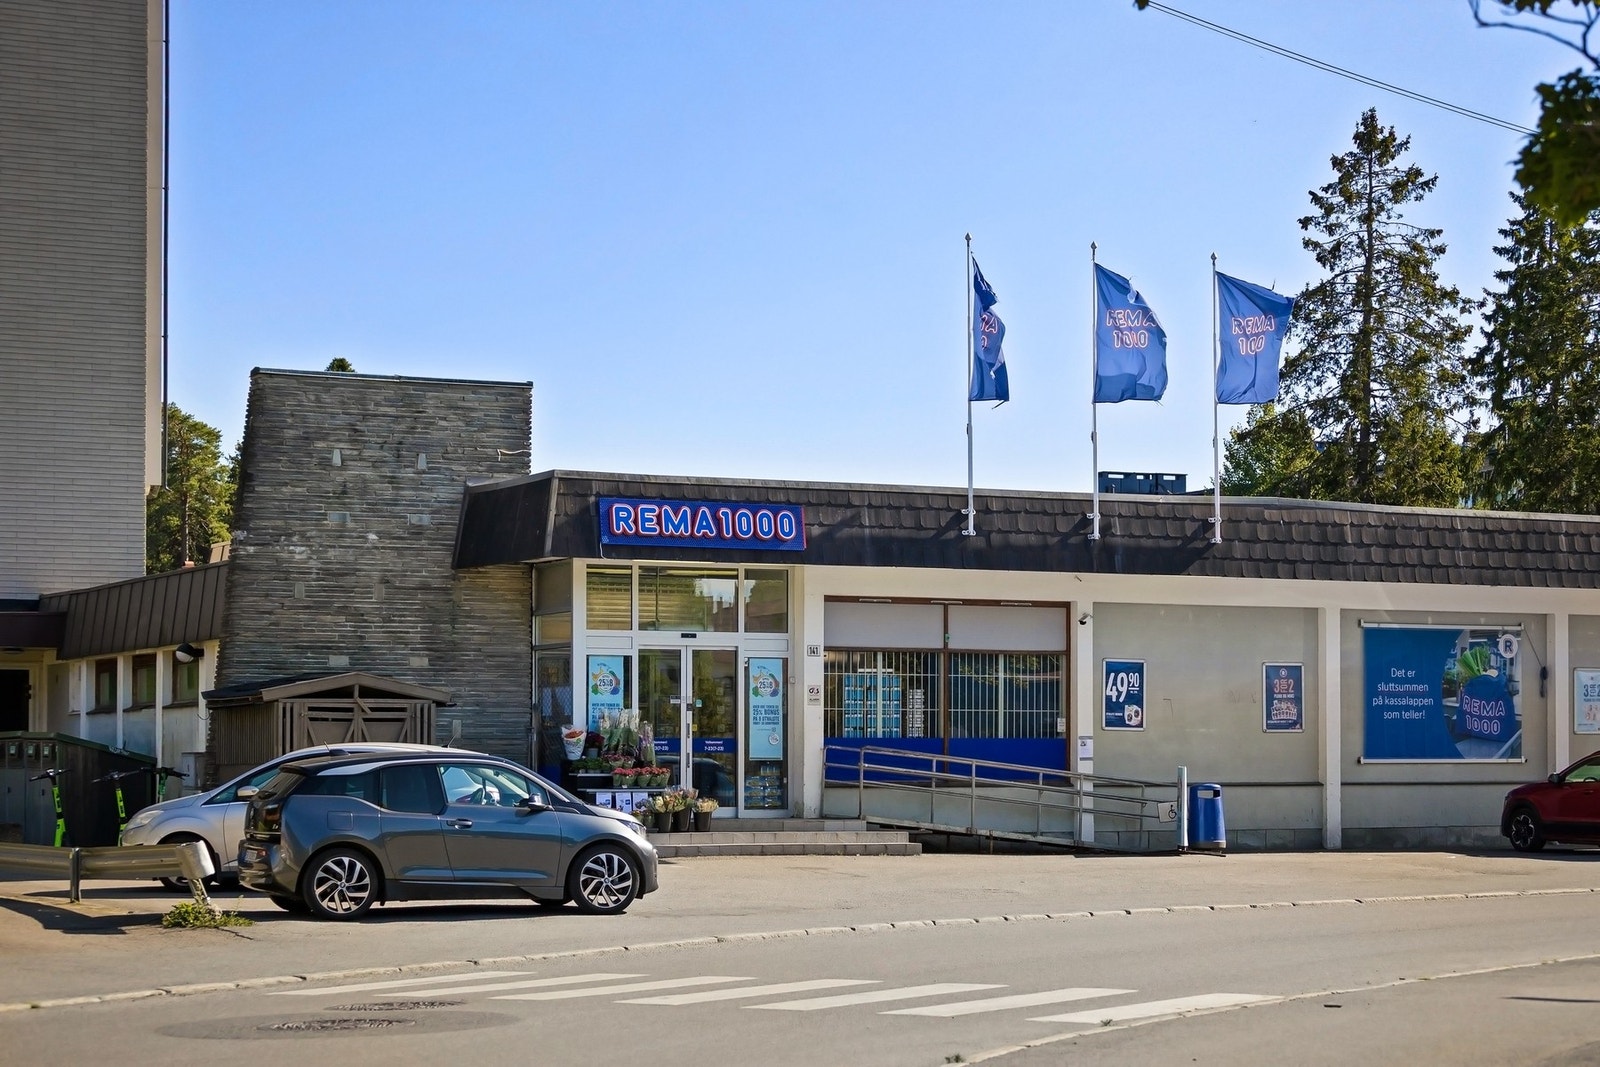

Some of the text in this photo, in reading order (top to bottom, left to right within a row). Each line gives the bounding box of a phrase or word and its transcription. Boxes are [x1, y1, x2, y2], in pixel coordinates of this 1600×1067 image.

[1232, 315, 1275, 335] REMA
[1391, 667, 1416, 678] Det er
[1377, 681, 1429, 692] sluttsummen
[1372, 695, 1434, 707] på kassalappen
[1463, 695, 1506, 717] REMA
[1383, 709, 1426, 719] som teller!
[1466, 714, 1501, 735] 1000
